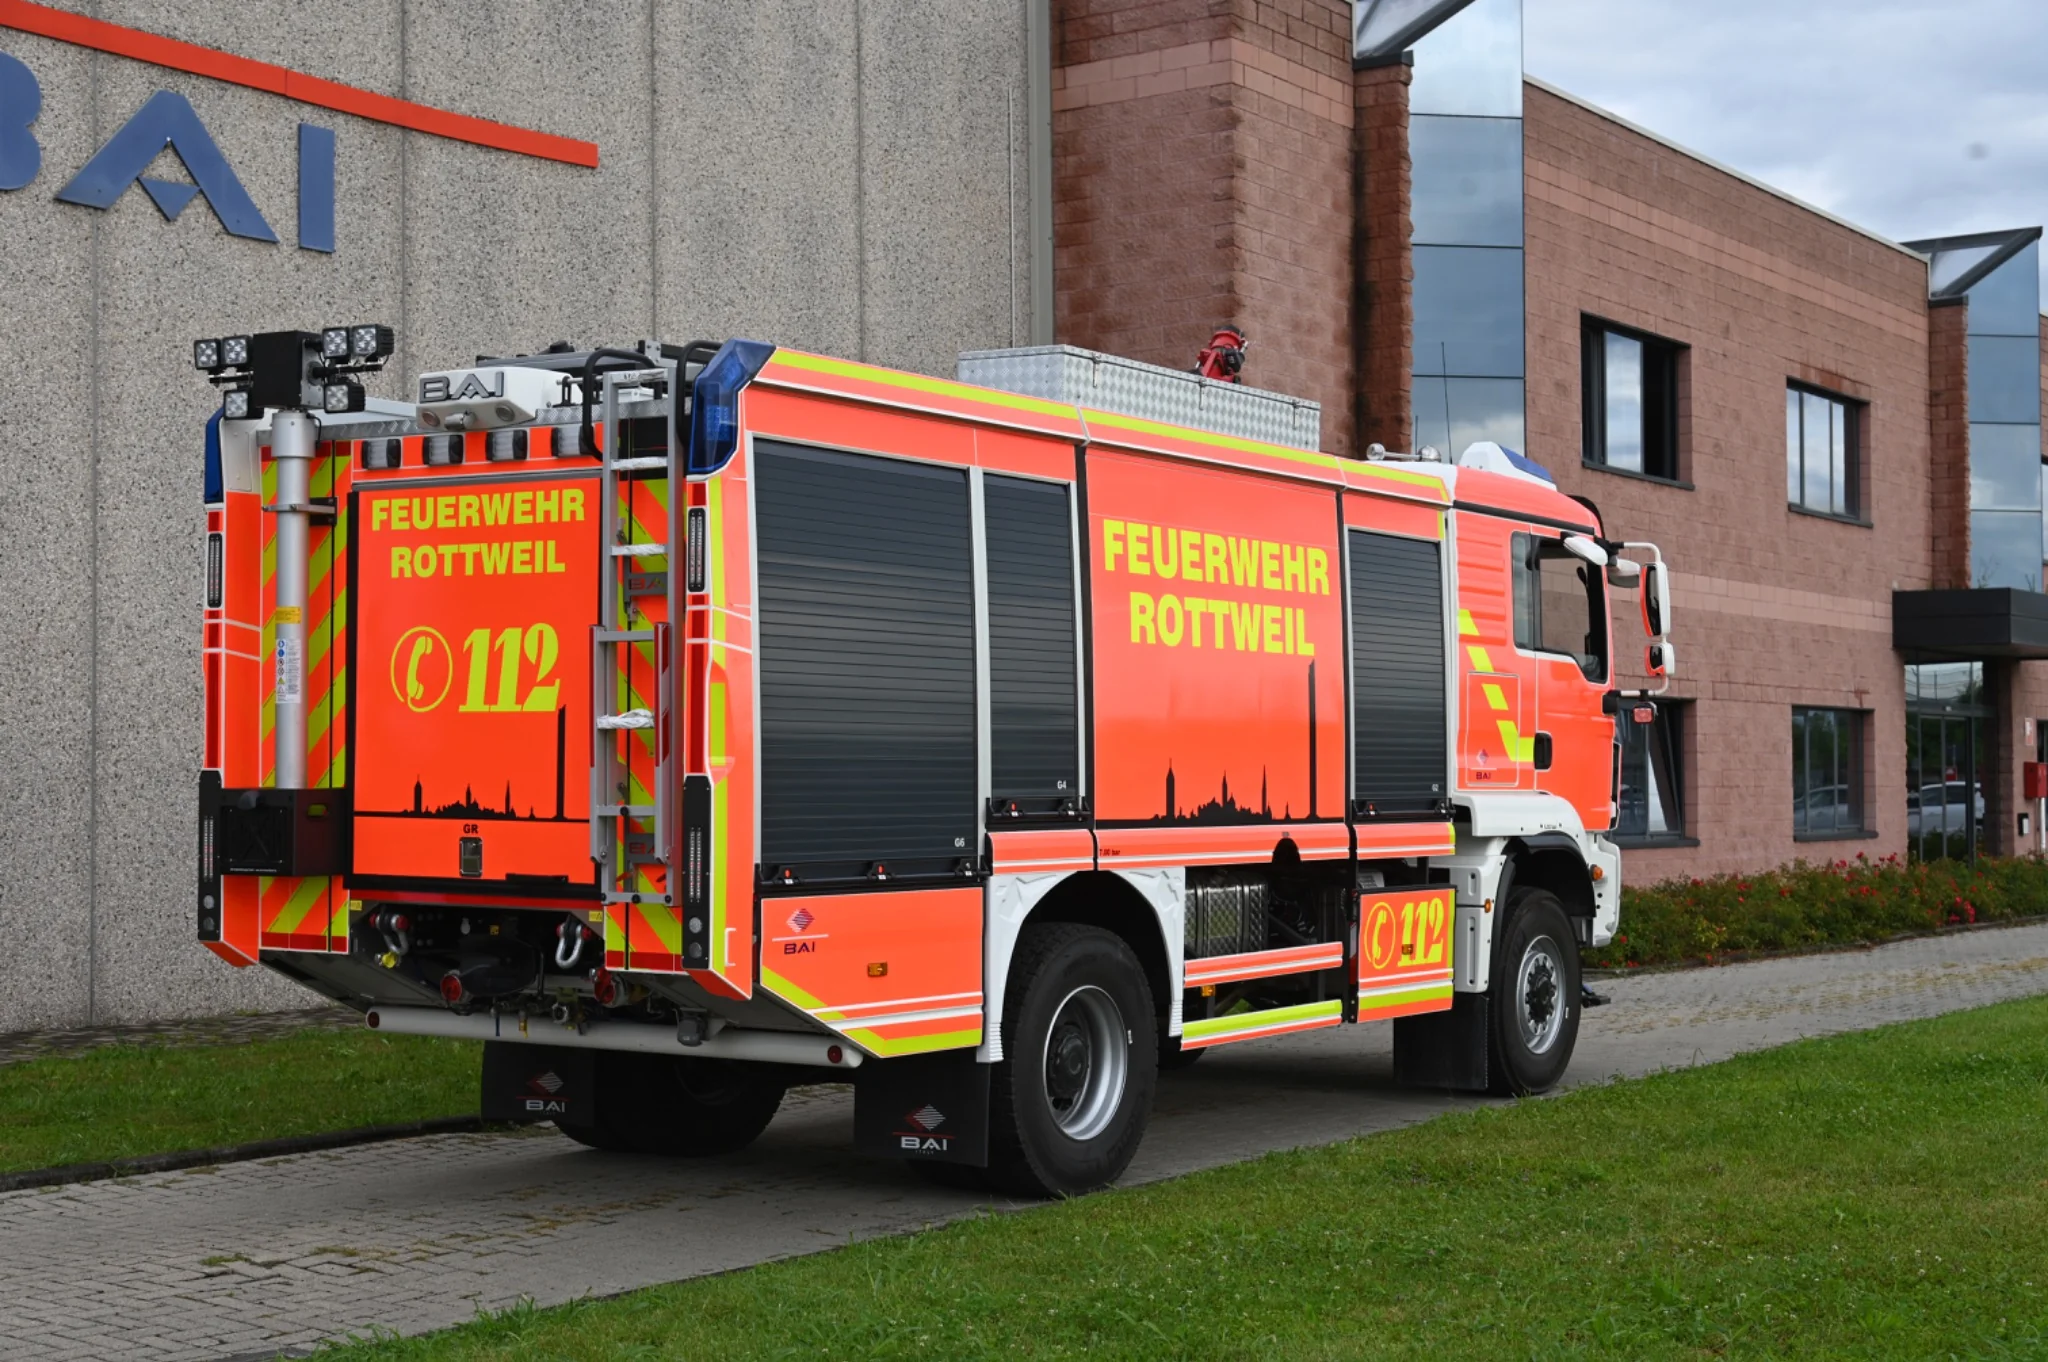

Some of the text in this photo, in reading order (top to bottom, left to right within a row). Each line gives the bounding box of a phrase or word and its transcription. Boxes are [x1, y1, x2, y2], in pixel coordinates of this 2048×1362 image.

[0, 51, 336, 253] AI
[419, 371, 504, 404] BAI
[371, 488, 585, 532] FEUERWEHR
[390, 540, 566, 579] ROTTWEIL
[1103, 518, 1331, 596] FEUERWEHR
[1129, 591, 1316, 657] ROTTWEIL
[458, 622, 561, 712] 112
[1056, 780, 1067, 790] G4
[1475, 771, 1492, 781] BAI
[462, 823, 479, 835] GR
[954, 837, 965, 848] G6
[783, 940, 816, 956] BAI
[1397, 897, 1445, 968] 112
[525, 1099, 566, 1113] BAI
[900, 1135, 948, 1151] BAI
